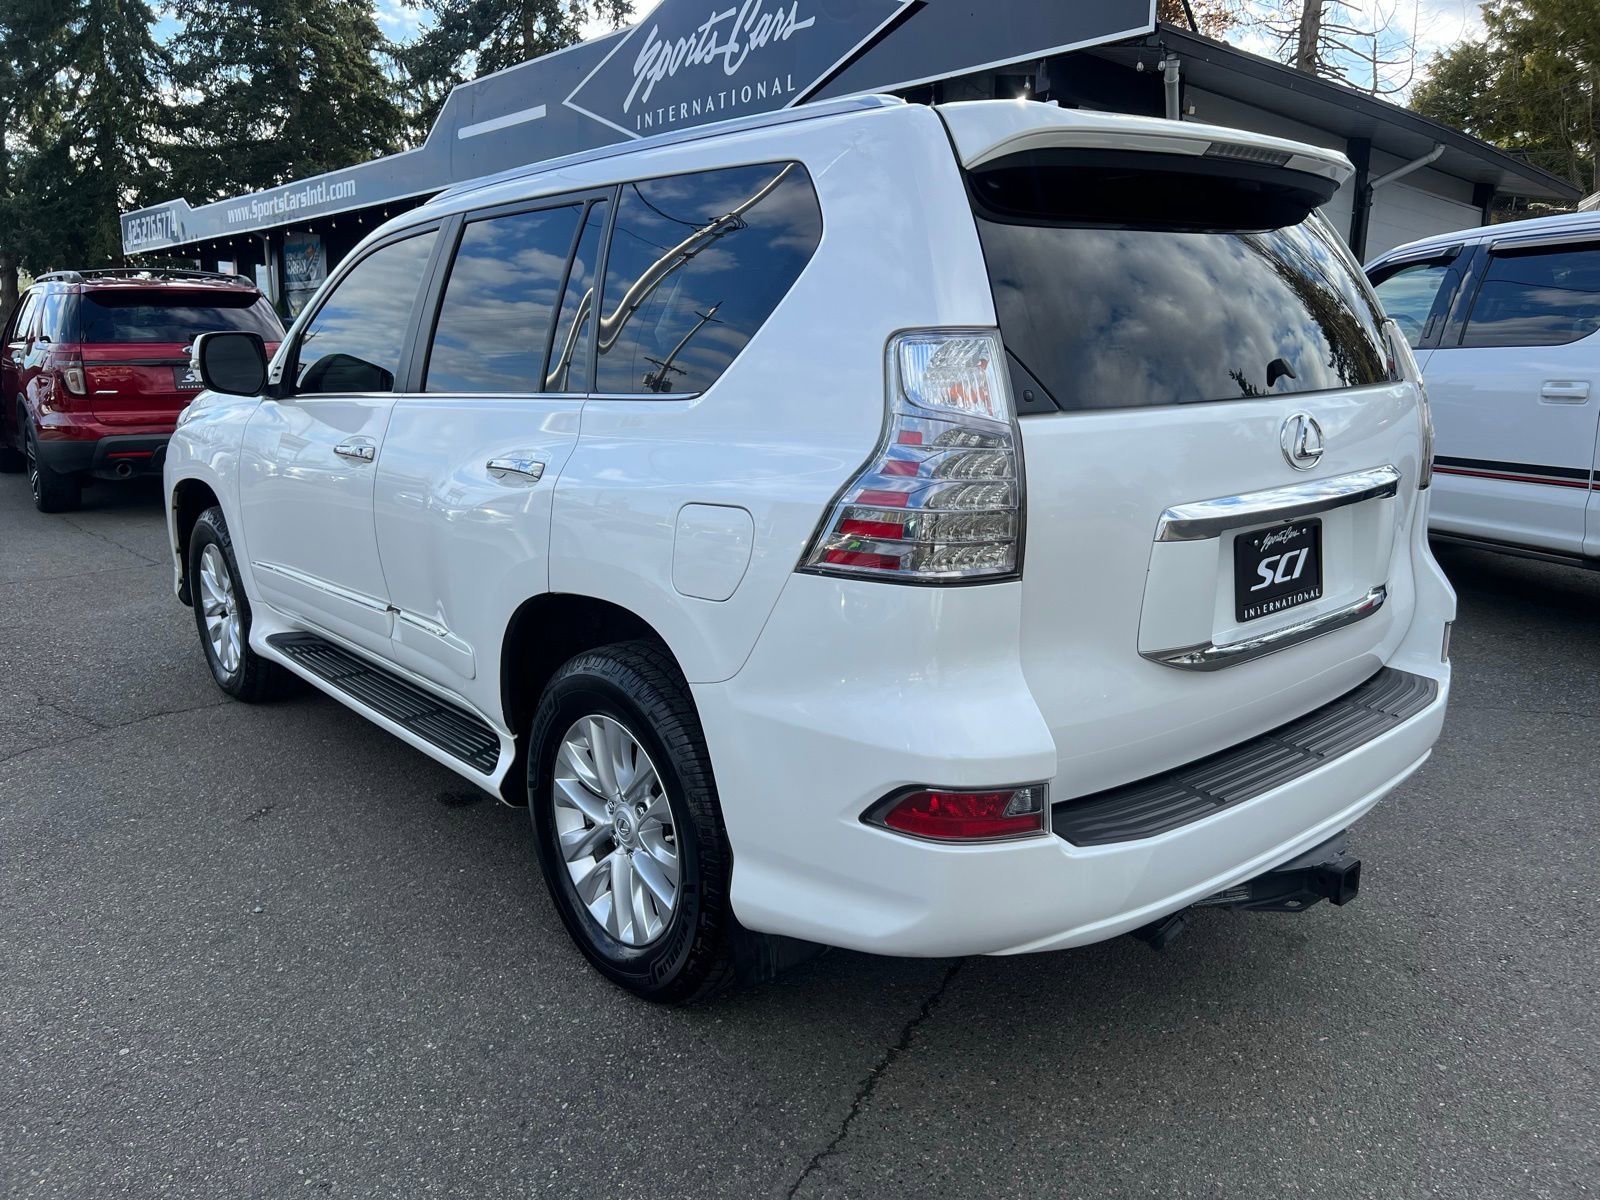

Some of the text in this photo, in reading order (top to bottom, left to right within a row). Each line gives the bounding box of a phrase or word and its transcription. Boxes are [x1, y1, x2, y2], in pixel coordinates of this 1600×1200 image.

[623, 0, 816, 114] Sports Cars
[636, 73, 797, 130] INTERNATIONAL
[227, 179, 357, 223] www.SportsCarsIntl.com
[1249, 547, 1309, 592] SCI
[1244, 588, 1321, 619] INTERNATIONAL
